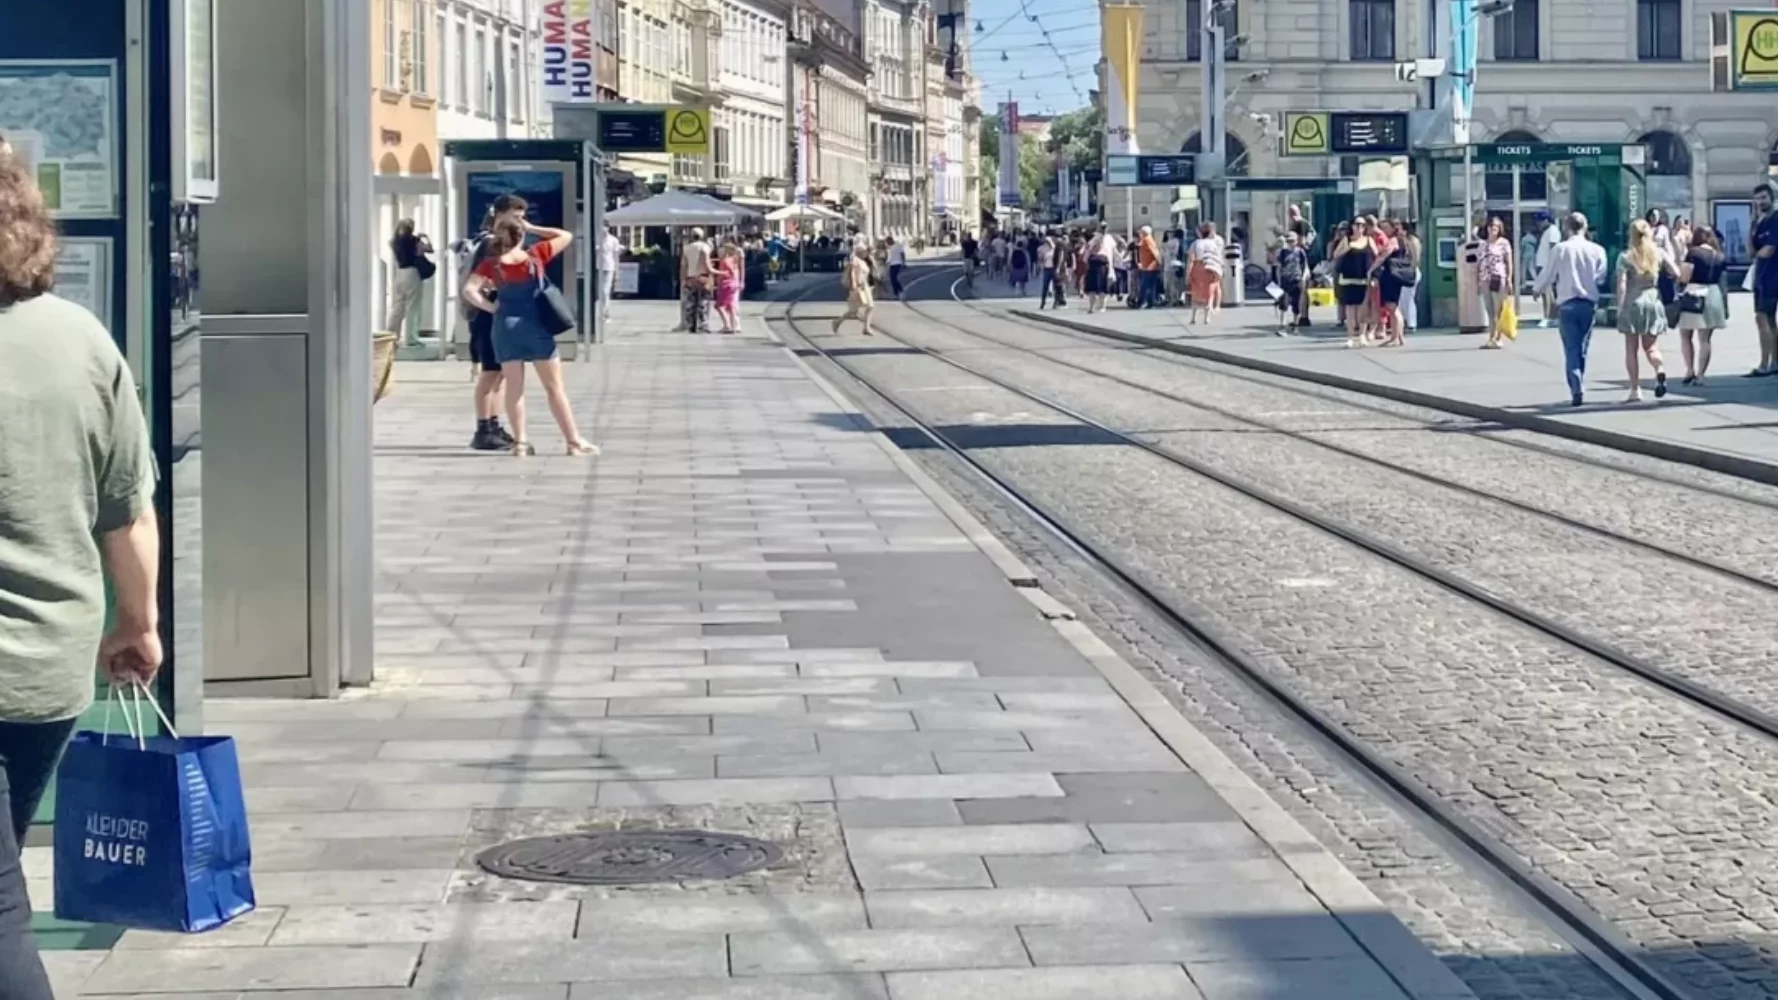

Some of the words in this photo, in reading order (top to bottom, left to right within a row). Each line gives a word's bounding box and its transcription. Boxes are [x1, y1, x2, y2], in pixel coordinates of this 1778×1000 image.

[1497, 146, 1532, 155] TICKETS
[1568, 146, 1602, 155] TICKETS
[84, 838, 146, 866] BAUER
